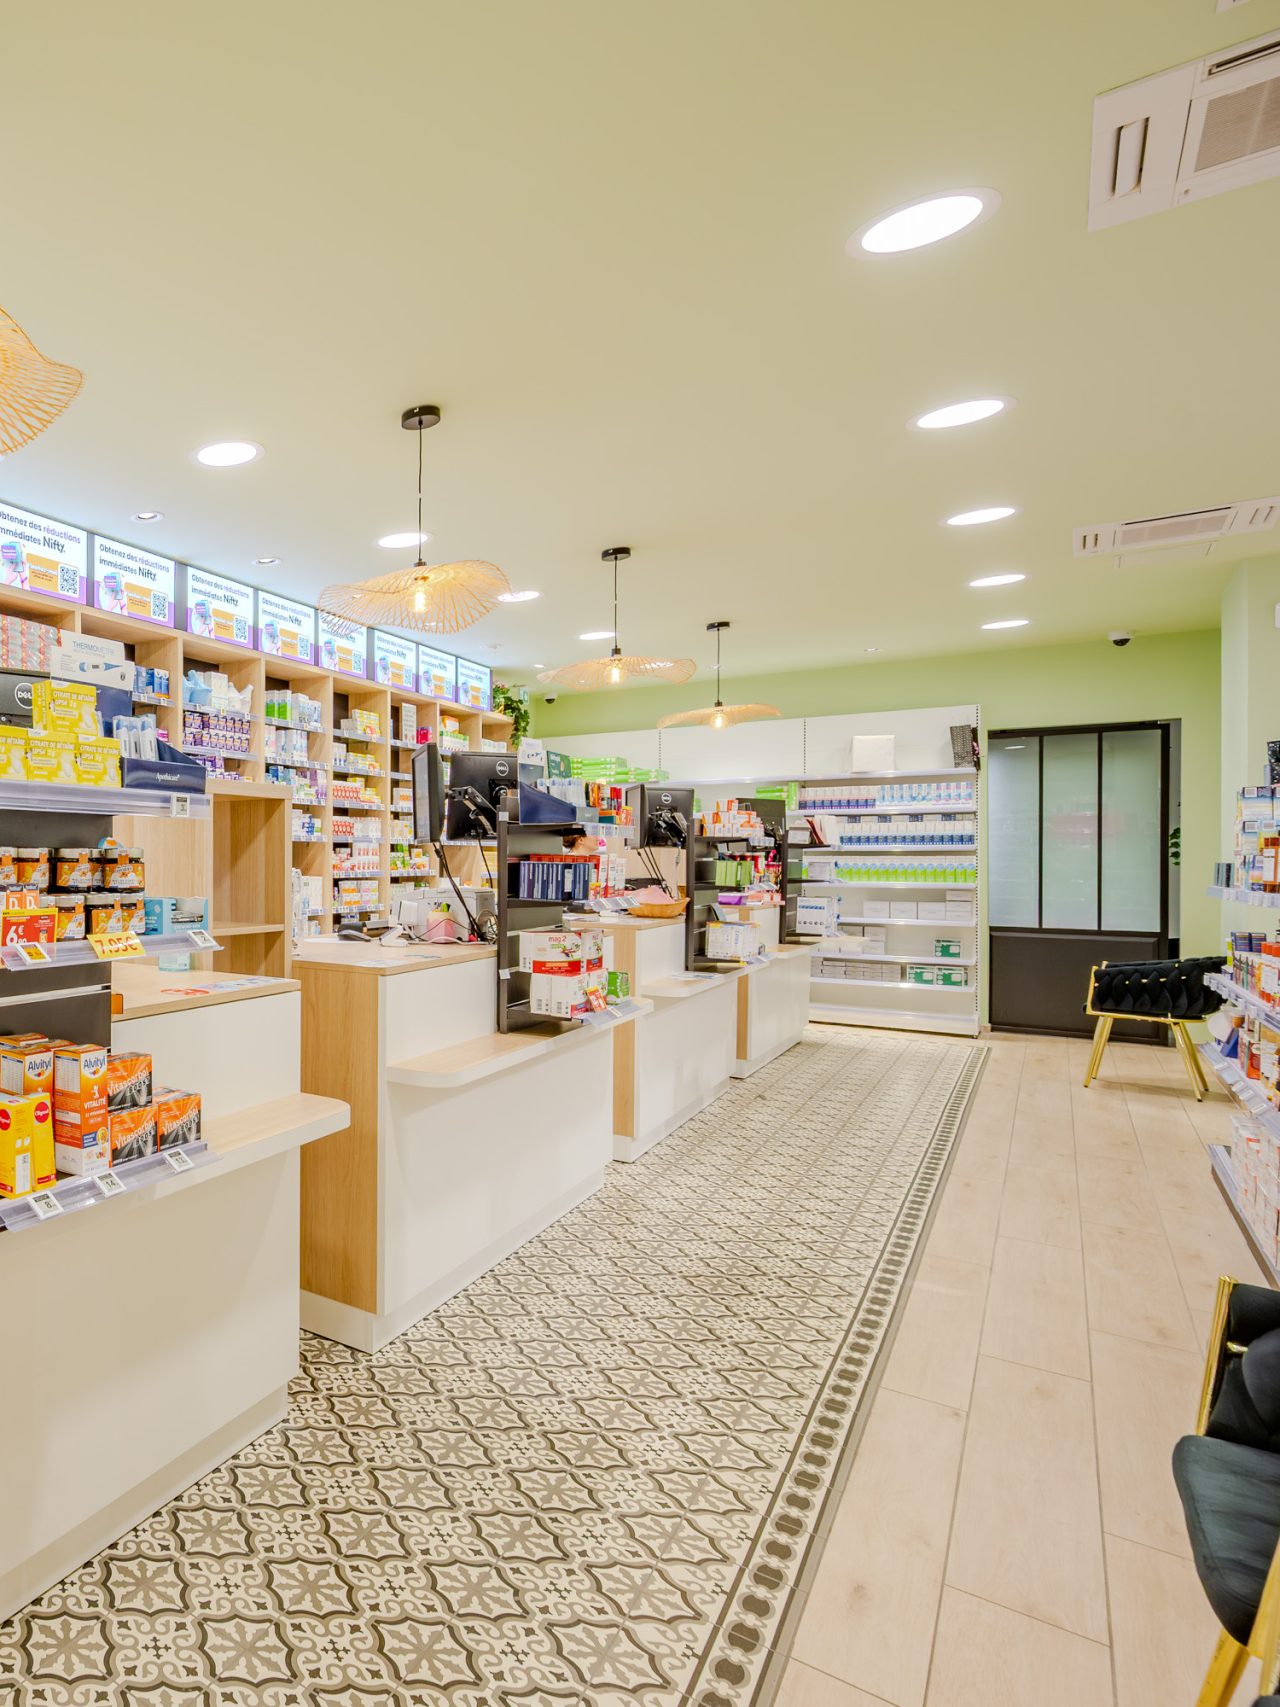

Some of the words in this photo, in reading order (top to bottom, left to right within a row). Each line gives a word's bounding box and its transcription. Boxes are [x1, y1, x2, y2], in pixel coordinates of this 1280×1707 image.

[29, 521, 42, 531] des
[43, 526, 81, 544] réductions
[99, 544, 126, 559] Obtenez
[126, 553, 138, 562] des
[139, 557, 169, 573] réductions
[99, 556, 137, 575] immédiates
[28, 1058, 52, 1072] Alvityl
[83, 1055, 105, 1069] Alvityl
[108, 1067, 149, 1096] Vitascorbol
[84, 1099, 106, 1109] VITALITÉ
[162, 1108, 199, 1135] Vitascorbol
[115, 1118, 154, 1149] Vitascorbol
